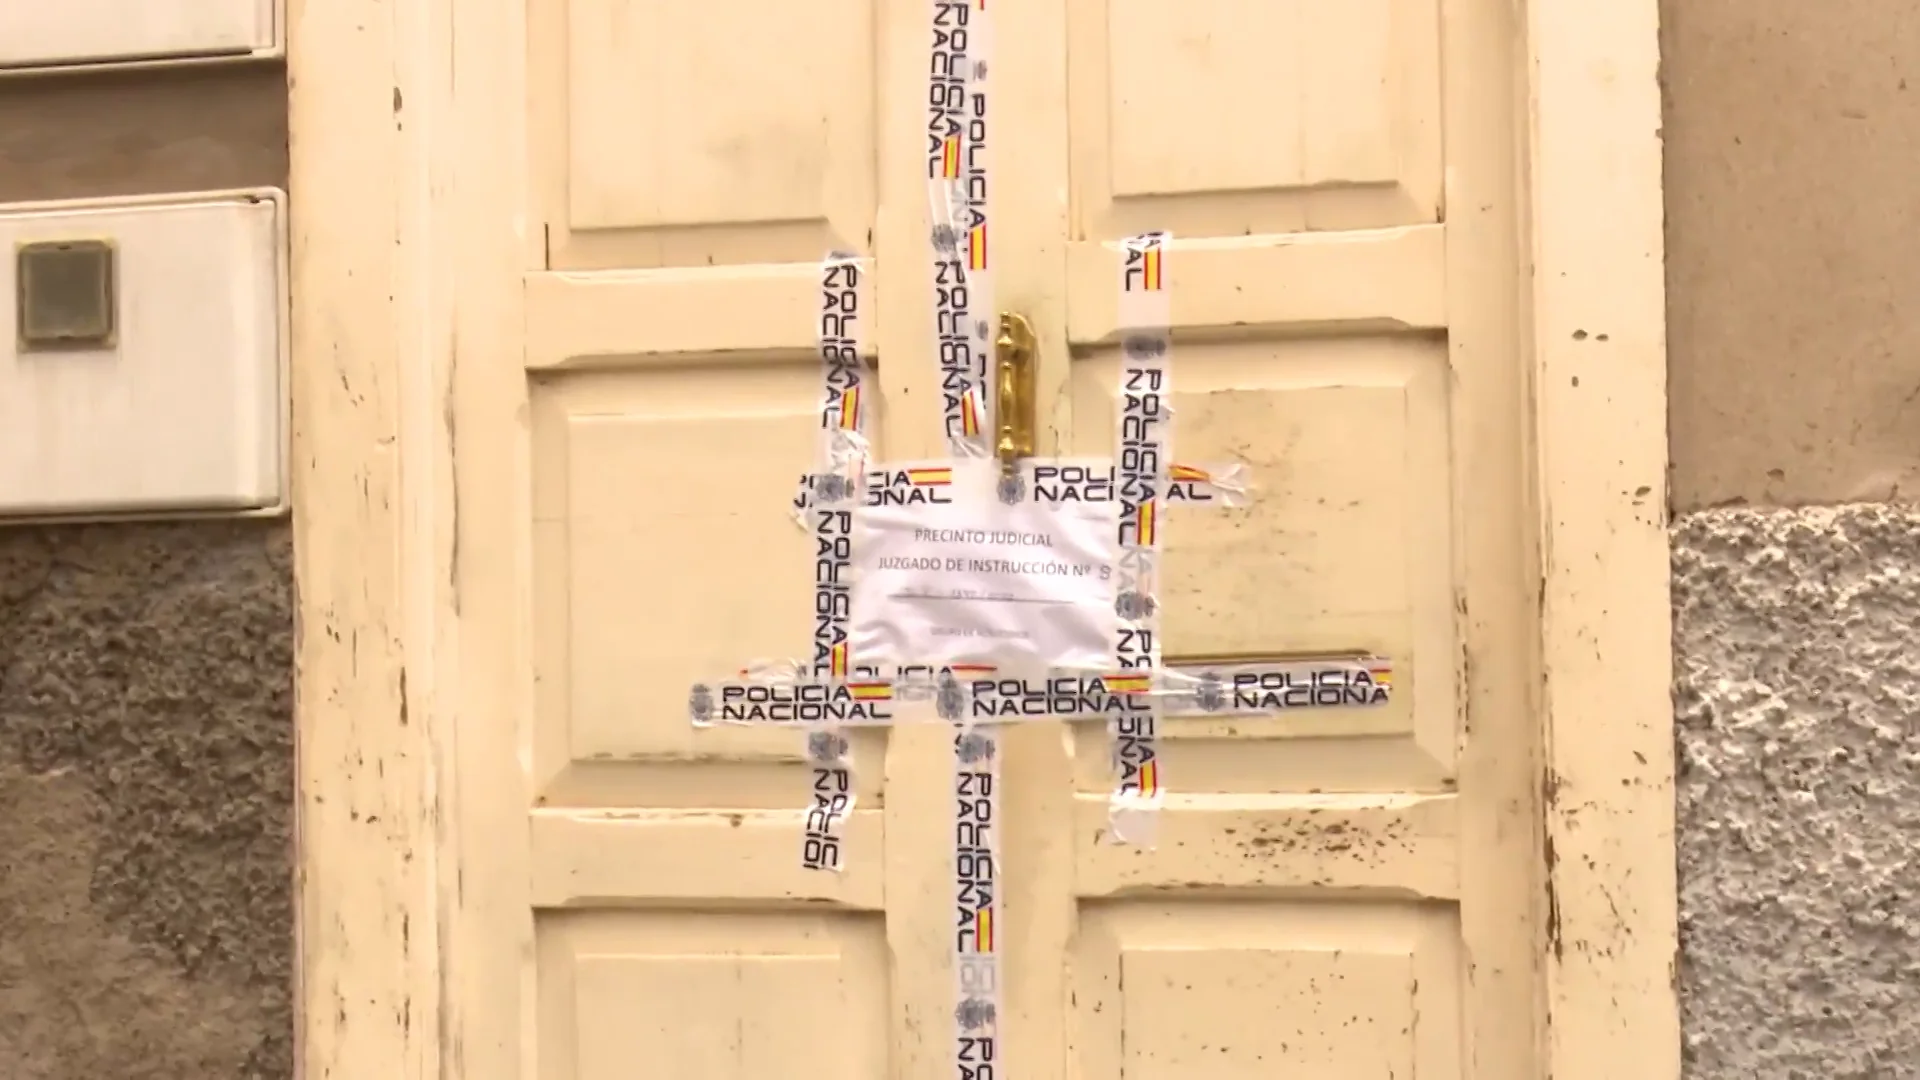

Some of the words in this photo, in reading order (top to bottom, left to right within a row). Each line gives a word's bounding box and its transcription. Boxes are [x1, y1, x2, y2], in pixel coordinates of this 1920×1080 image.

[928, 3, 950, 179] NACIONAL
[945, 3, 968, 137] POLICIA
[969, 93, 986, 227] POLICIA
[822, 266, 842, 428] NACIONAL
[840, 265, 860, 389] POLICIA
[1118, 369, 1143, 545] NACIONAL
[1138, 369, 1162, 502] POLICIA
[814, 511, 834, 676] NACIONAL
[832, 511, 851, 644] POLICIA
[878, 556, 941, 572] JUZGADO
[945, 558, 963, 572] DE
[968, 556, 1068, 576] INSTRUCCIÓN
[914, 528, 985, 545] PRECINTO
[989, 531, 1052, 547] JUDICIAL
[722, 684, 851, 702] POLICIA
[722, 703, 892, 720] NACIONAL
[972, 677, 1106, 698] POLICIA
[973, 694, 1152, 716] NACIONAL
[1233, 670, 1372, 690] POLICIA
[1234, 687, 1389, 708] NACIONA
[821, 769, 849, 866] POLIC
[957, 772, 975, 952] NACIONAL
[975, 772, 993, 910] POLICIA
